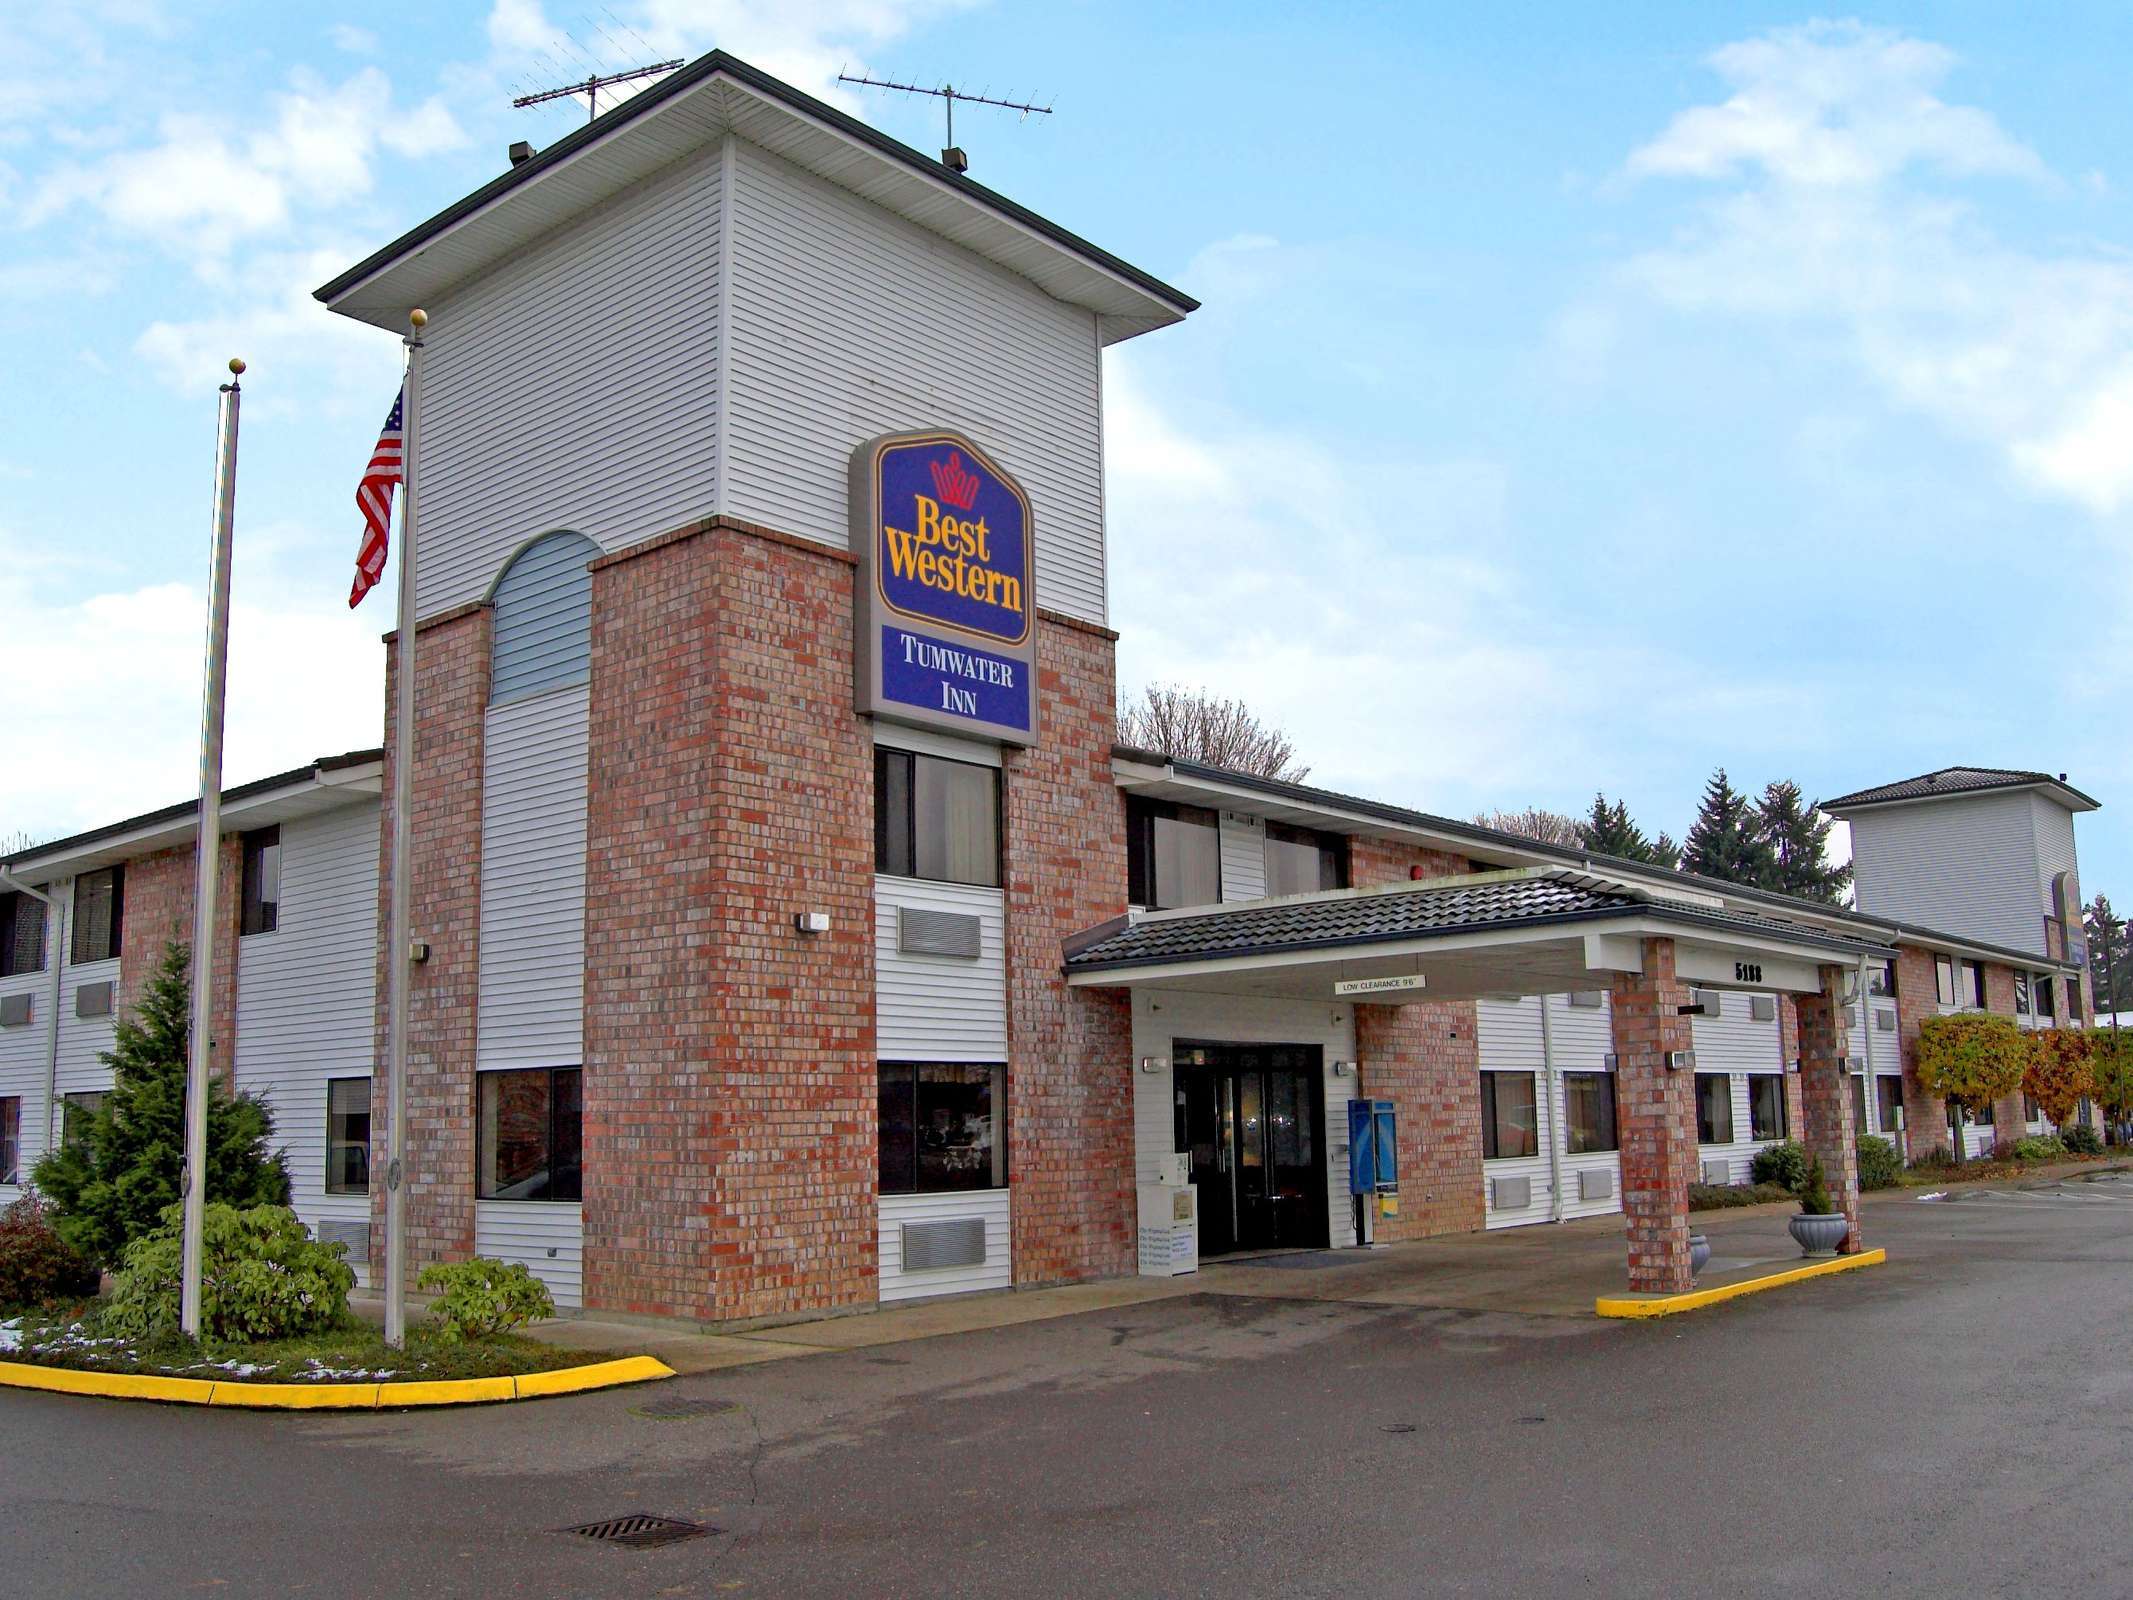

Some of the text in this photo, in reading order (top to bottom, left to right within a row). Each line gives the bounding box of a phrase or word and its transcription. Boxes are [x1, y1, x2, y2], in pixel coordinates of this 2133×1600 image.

[915, 494, 990, 562] Best
[885, 526, 1023, 613] Western
[900, 633, 1014, 689] TUMWATER
[941, 681, 977, 716] INN
[1343, 983, 1358, 991] LOW
[1360, 979, 1400, 990] CLEARANCE
